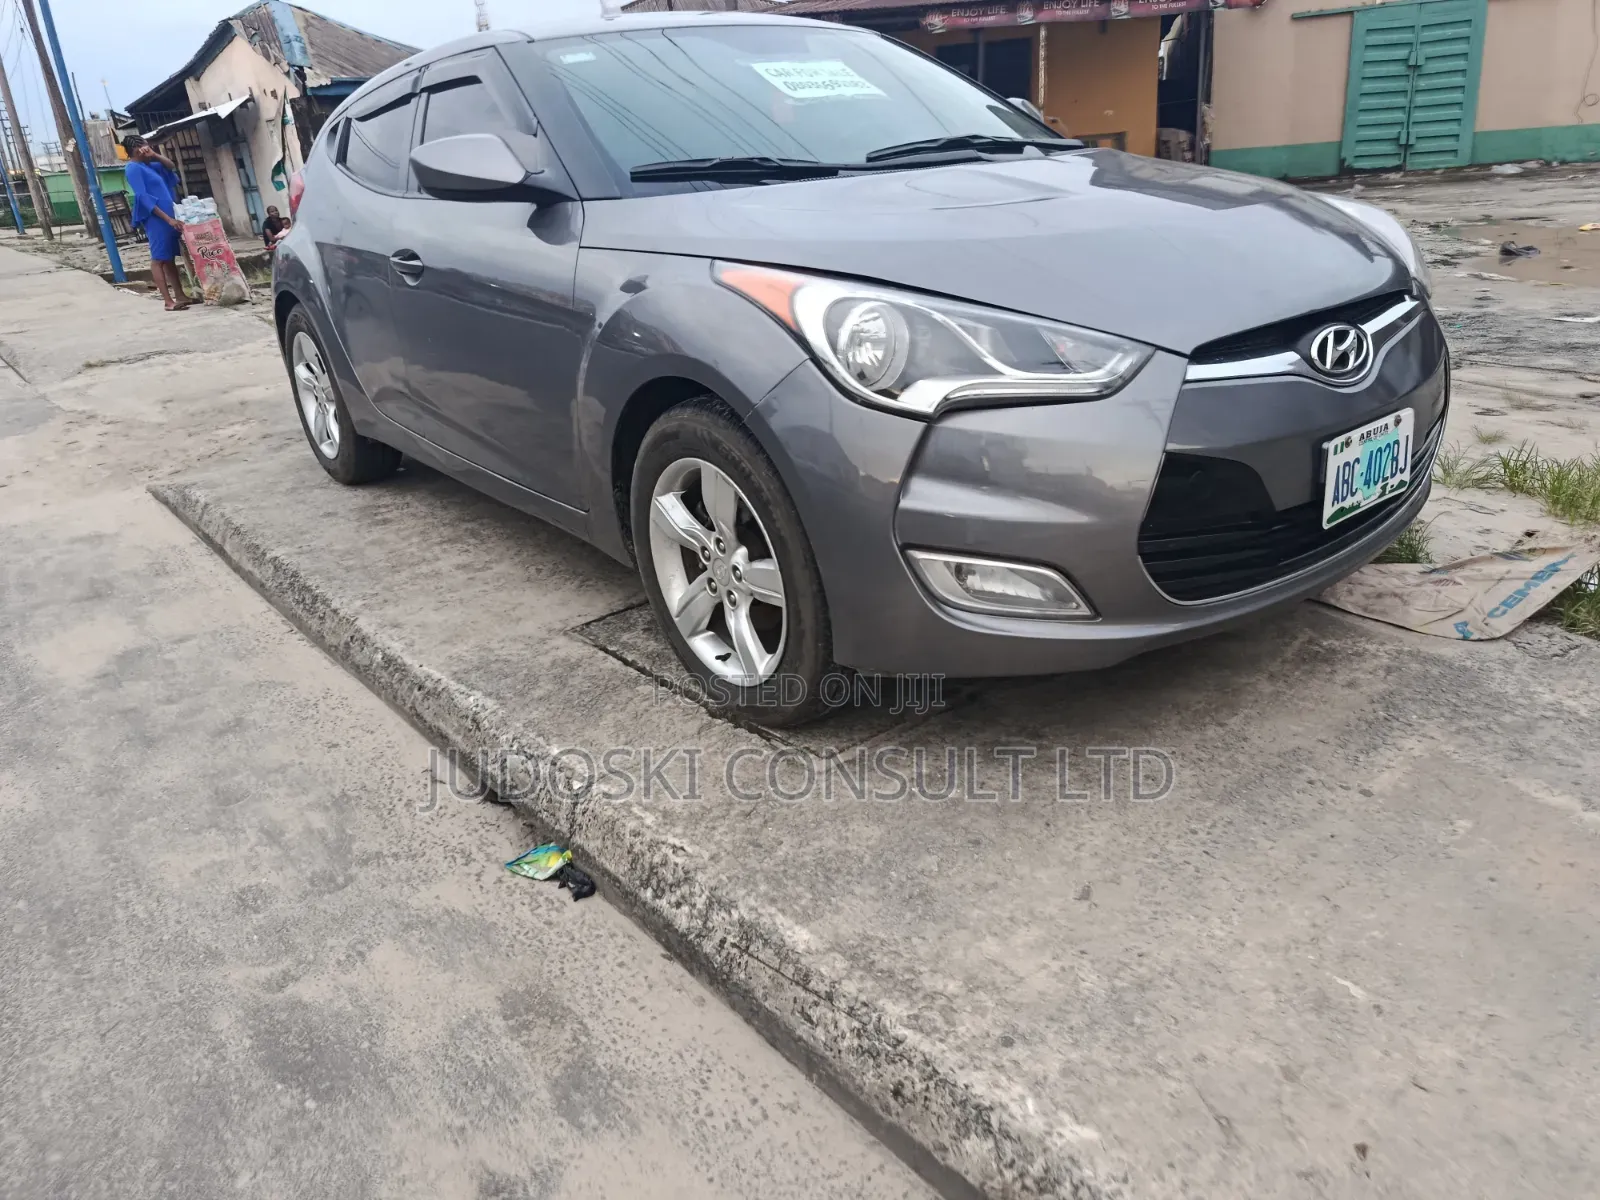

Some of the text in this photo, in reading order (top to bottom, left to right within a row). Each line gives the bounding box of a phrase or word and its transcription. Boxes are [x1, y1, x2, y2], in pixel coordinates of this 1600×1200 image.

[1043, 0, 1100, 10] ENJOY LIFE
[951, 8, 985, 18] ENJOY
[1358, 422, 1389, 442] ABUJA
